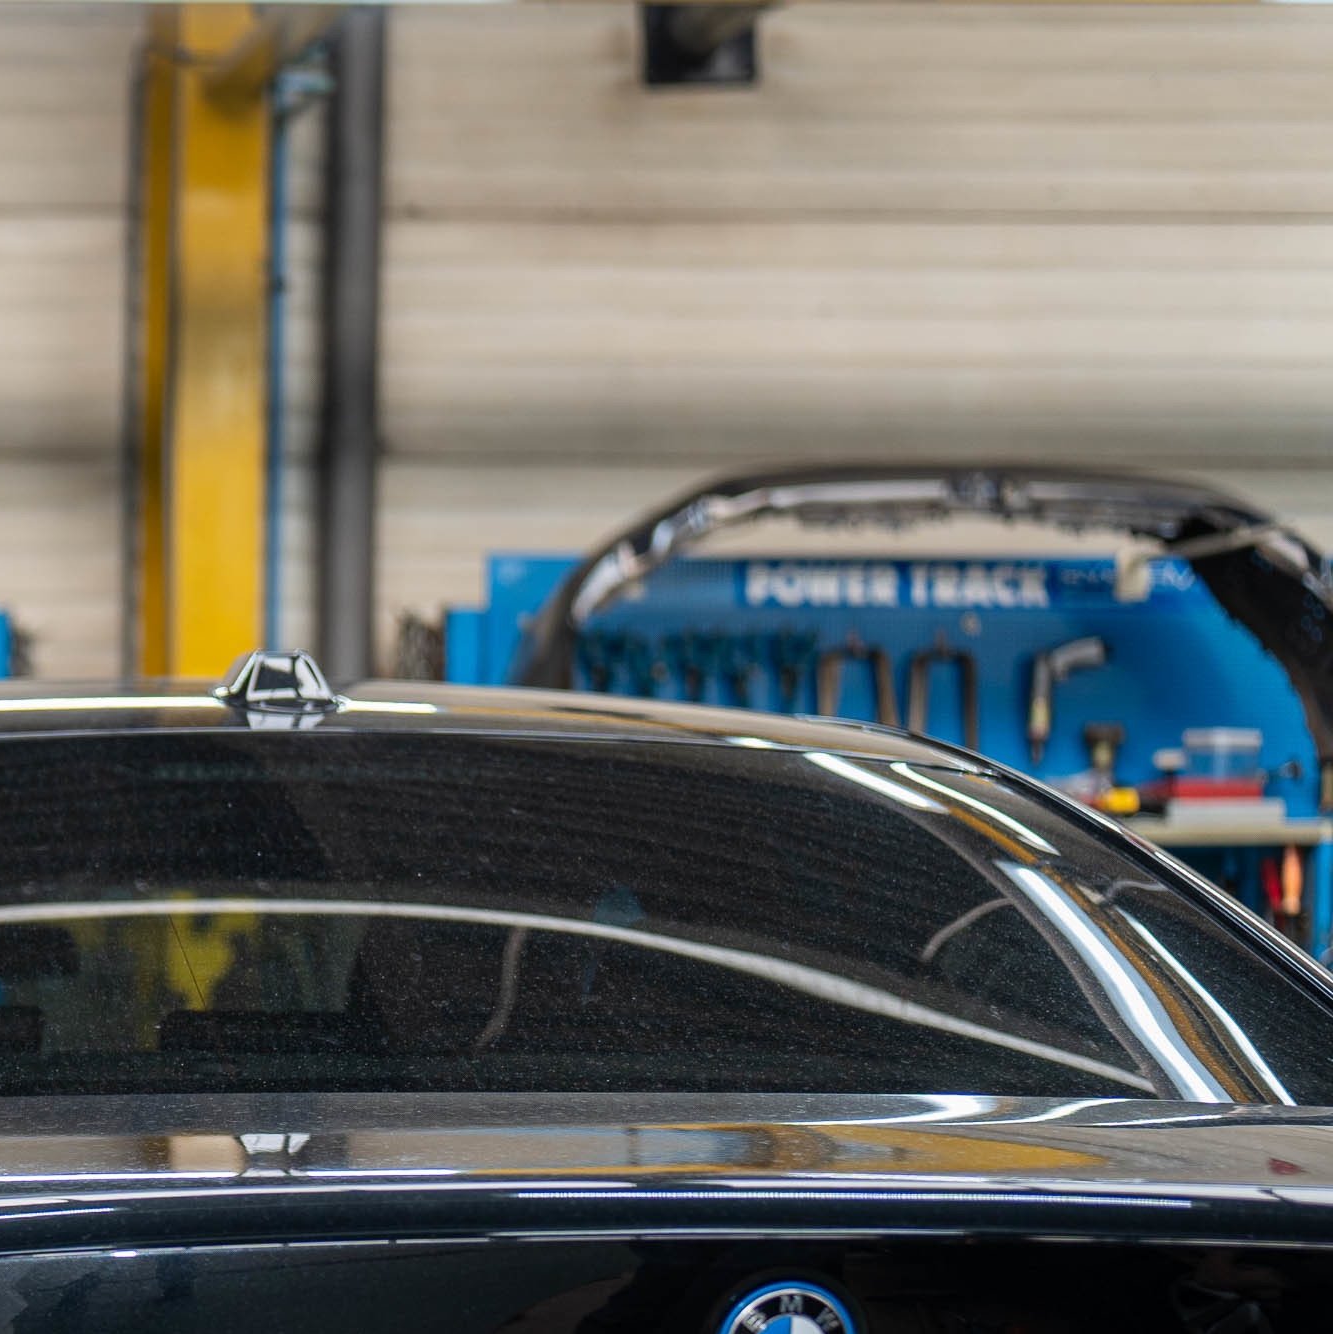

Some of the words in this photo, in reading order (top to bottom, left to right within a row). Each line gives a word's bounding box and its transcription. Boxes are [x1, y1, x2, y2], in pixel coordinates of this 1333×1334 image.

[745, 562, 900, 607] POWER
[910, 562, 1050, 607] TRACK
[741, 1294, 840, 1333] BMW
